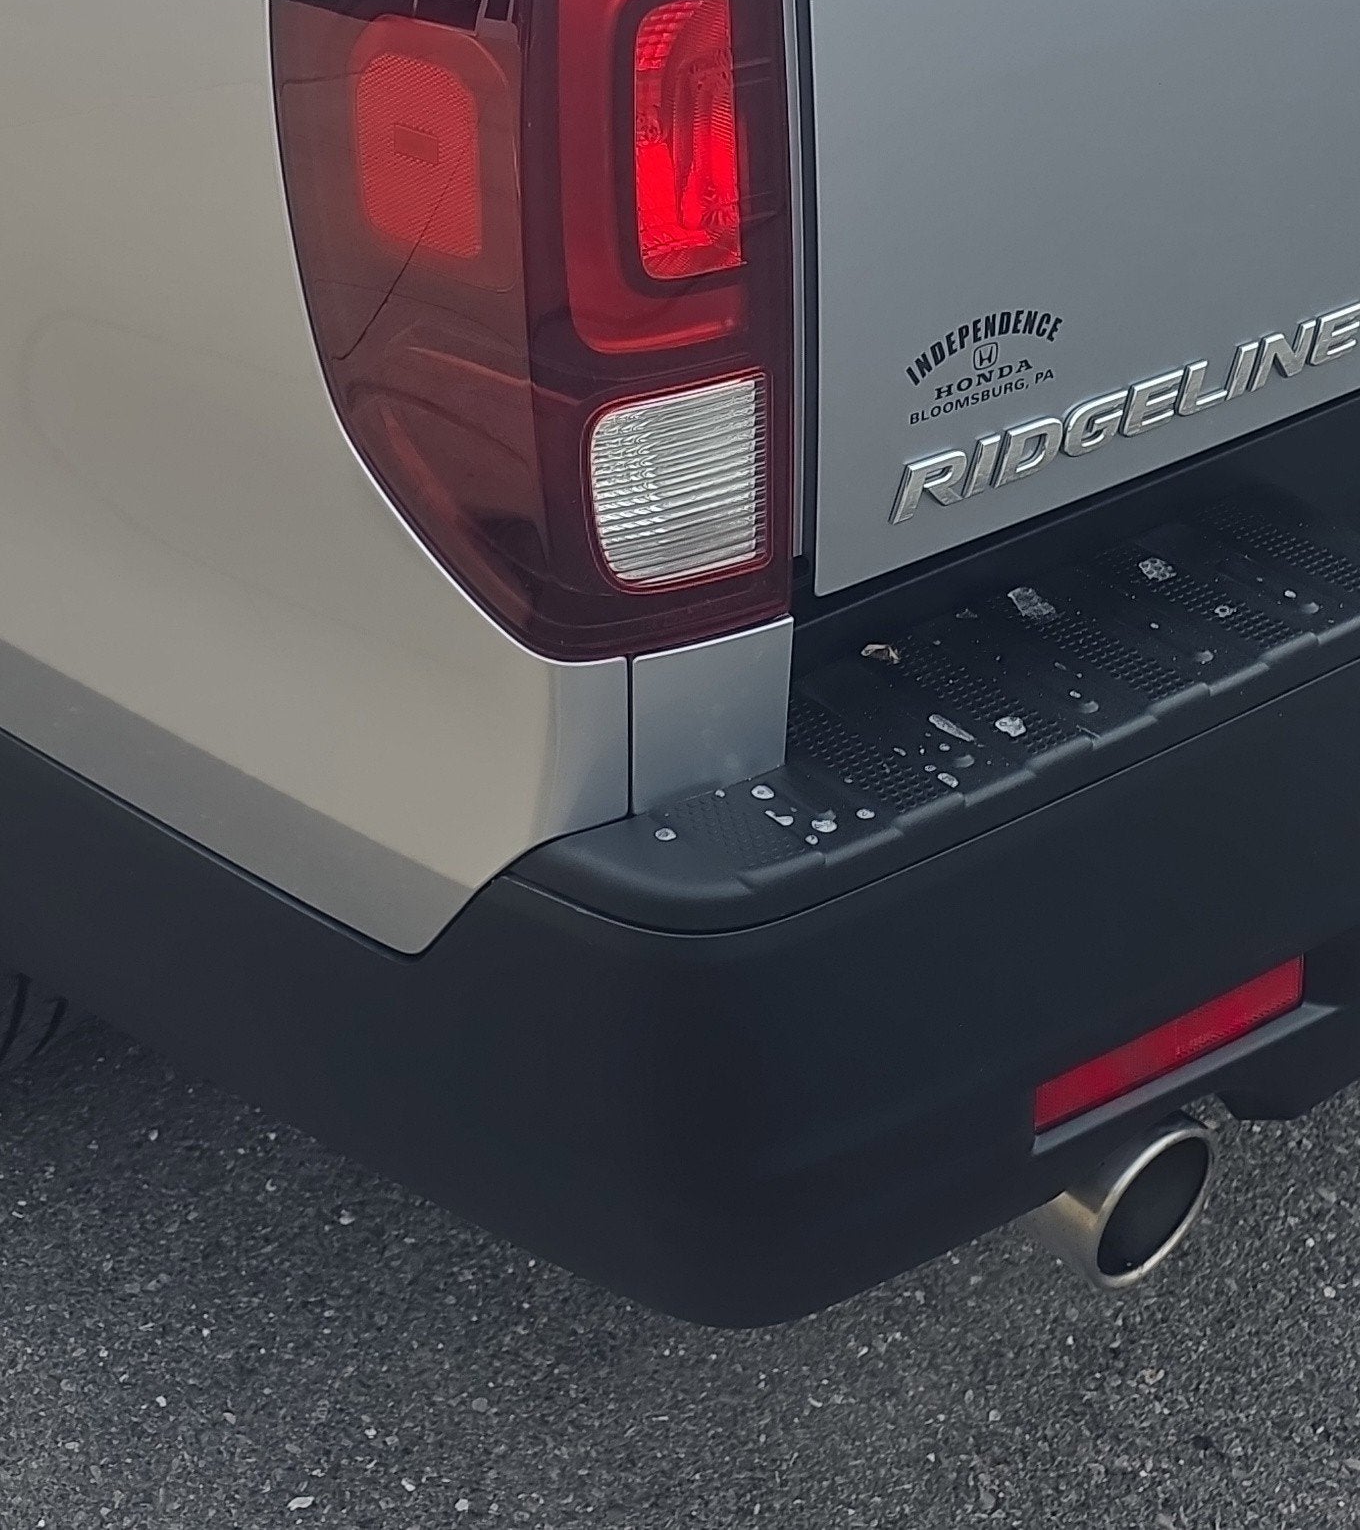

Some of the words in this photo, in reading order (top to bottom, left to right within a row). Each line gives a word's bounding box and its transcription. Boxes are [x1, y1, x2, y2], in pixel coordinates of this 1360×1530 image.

[905, 309, 1063, 387] INDEPENDENCE
[909, 378, 1030, 425] BLOOMSBURG,
[1034, 368, 1054, 385] PA
[934, 358, 1033, 401] HONDA
